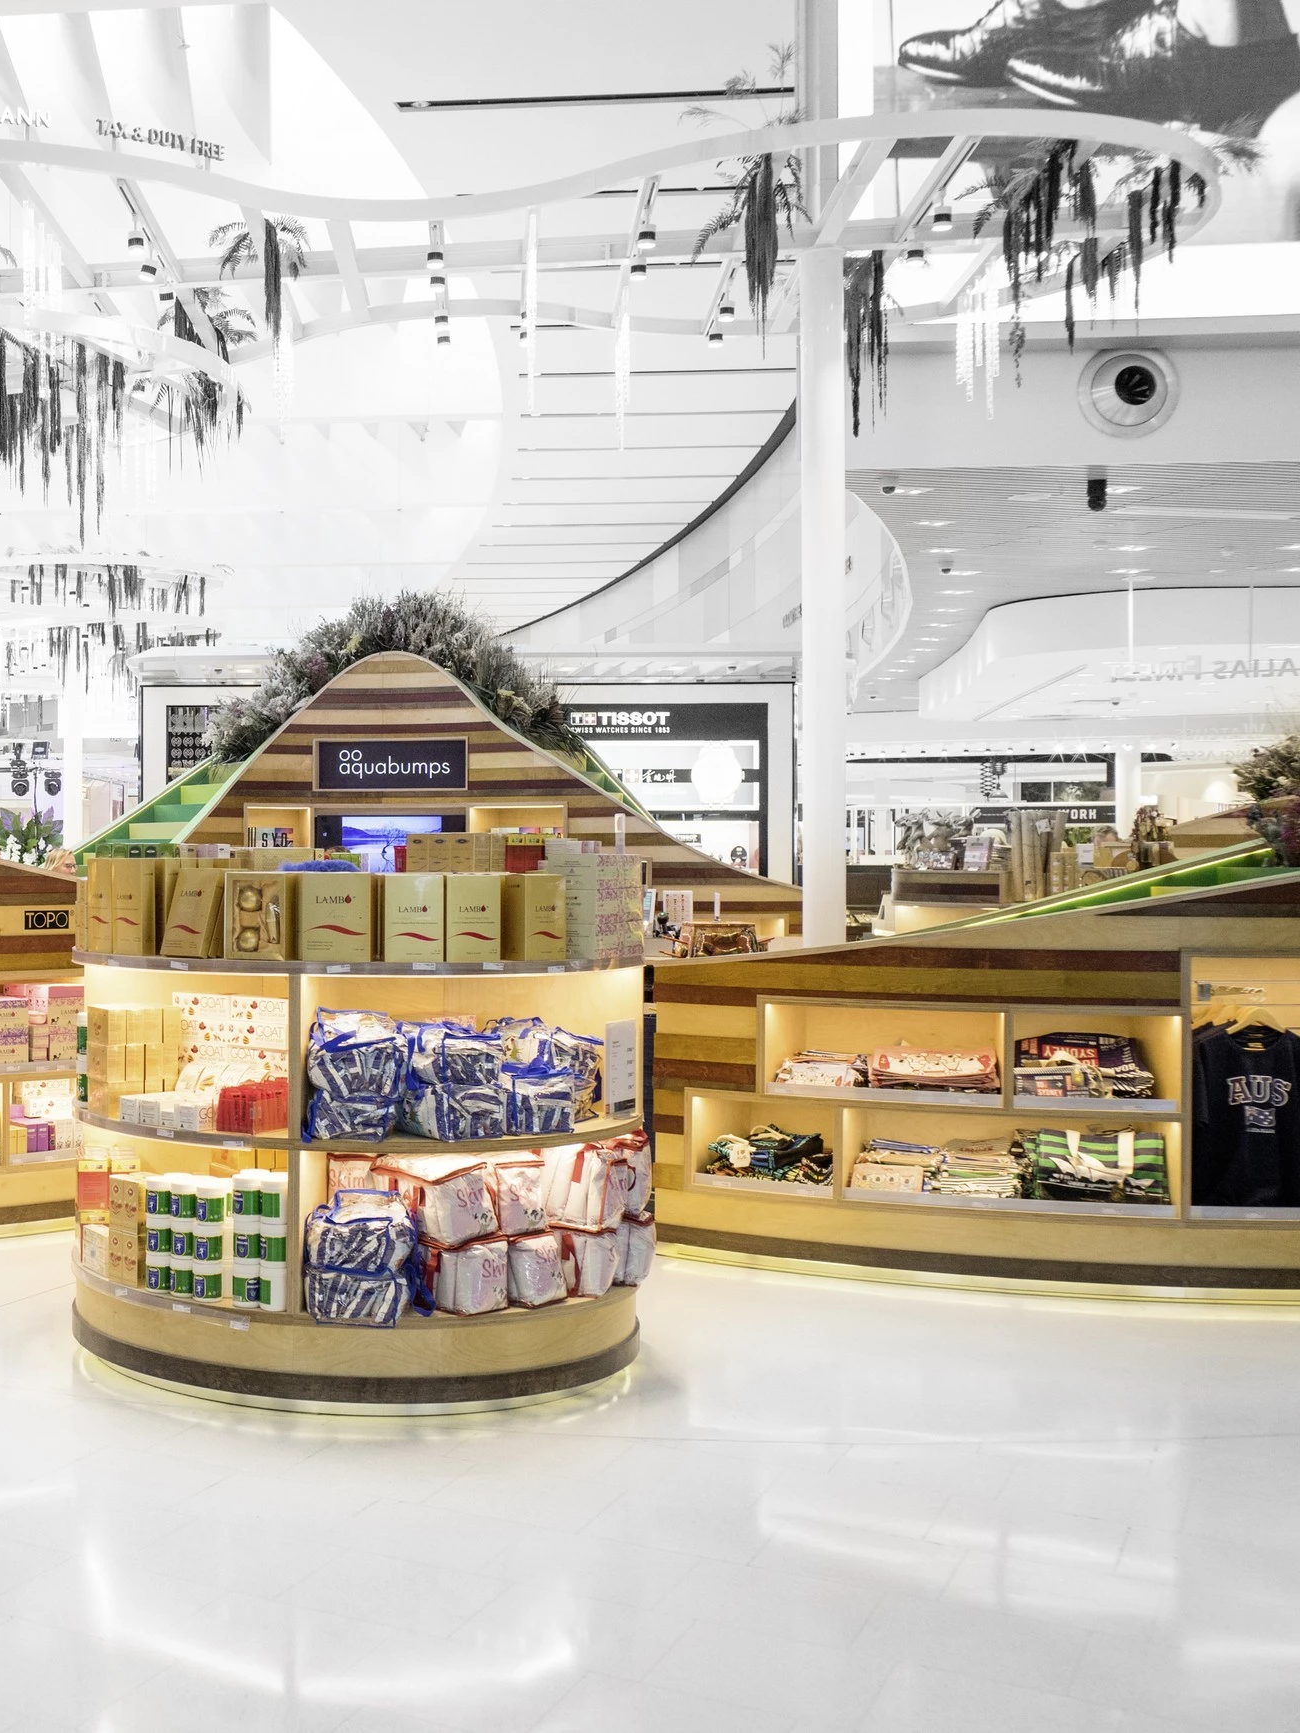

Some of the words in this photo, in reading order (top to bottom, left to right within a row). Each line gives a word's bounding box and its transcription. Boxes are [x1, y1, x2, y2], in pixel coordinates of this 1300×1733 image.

[96, 118, 129, 139] TAX
[147, 128, 192, 150] DUTY
[194, 134, 226, 161] FREE
[597, 711, 671, 726] TISSOT
[595, 726, 629, 734] WATCHES
[630, 726, 652, 734] SINCE
[654, 726, 671, 734] 1853
[338, 756, 451, 779] aquabumps
[25, 912, 68, 929] TOPO
[200, 996, 226, 1009] GOAT
[258, 1000, 286, 1013] GOAT
[180, 1019, 199, 1031] OAT
[256, 1025, 284, 1038] GOAT
[199, 1044, 225, 1057] GOAT
[230, 1047, 256, 1059] GOAT
[1227, 1075, 1292, 1107] AUS
